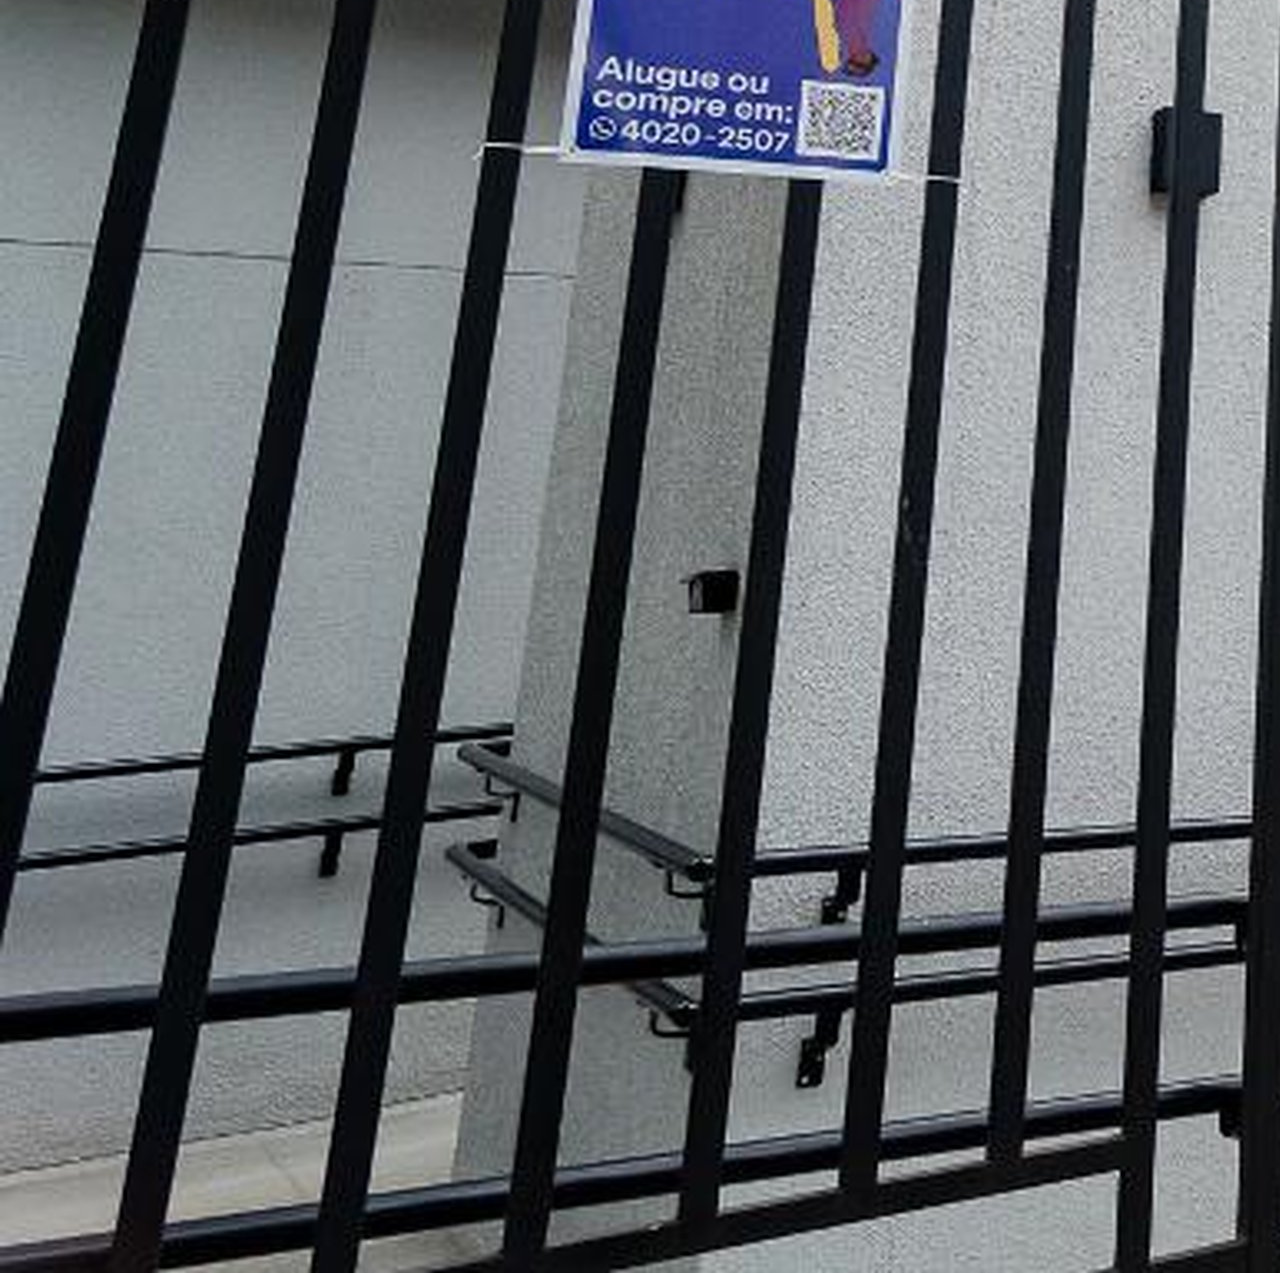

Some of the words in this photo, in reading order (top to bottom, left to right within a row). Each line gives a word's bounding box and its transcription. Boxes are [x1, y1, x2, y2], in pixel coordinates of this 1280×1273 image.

[596, 55, 720, 91] Alugue
[728, 71, 769, 95] ou
[592, 88, 726, 120] compre
[734, 96, 794, 124] em:
[622, 120, 790, 154] 4020-2507
